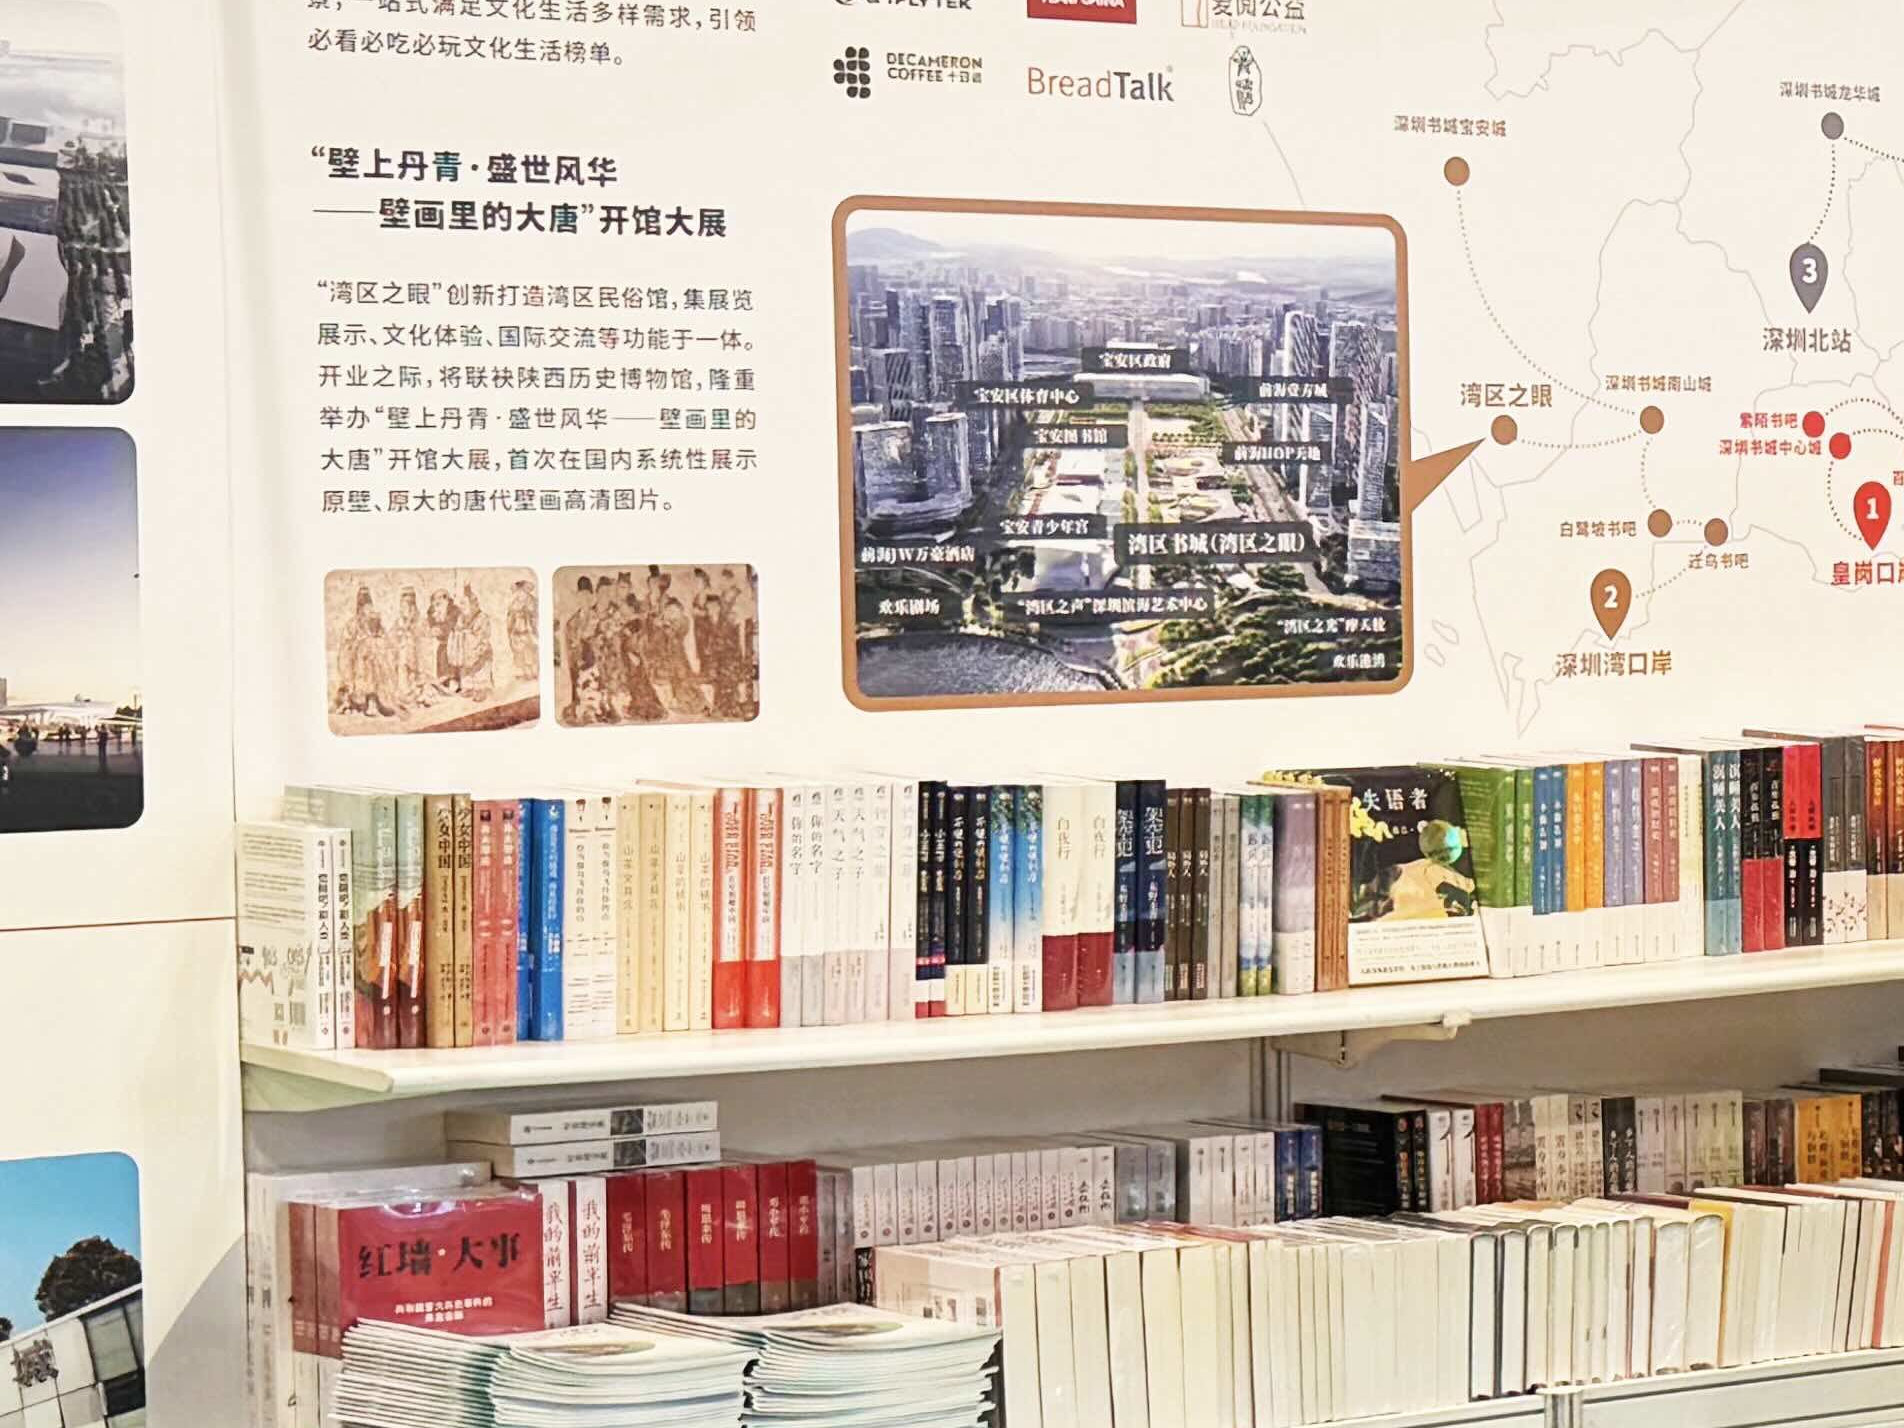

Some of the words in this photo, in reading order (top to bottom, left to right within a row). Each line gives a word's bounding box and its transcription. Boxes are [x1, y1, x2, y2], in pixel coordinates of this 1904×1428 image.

[886, 52, 982, 69] DECAMERON
[887, 68, 943, 83] COFFEE
[1028, 67, 1175, 103] BreadTalk
[1801, 258, 1819, 284] 3
[1762, 327, 1852, 355] 深圳北站
[1460, 383, 1554, 409] 湾区之眼
[1866, 496, 1879, 521] 1
[1603, 587, 1619, 610] 2
[1555, 652, 1673, 679] 深圳湾口岸
[1363, 787, 1428, 811] 失语者
